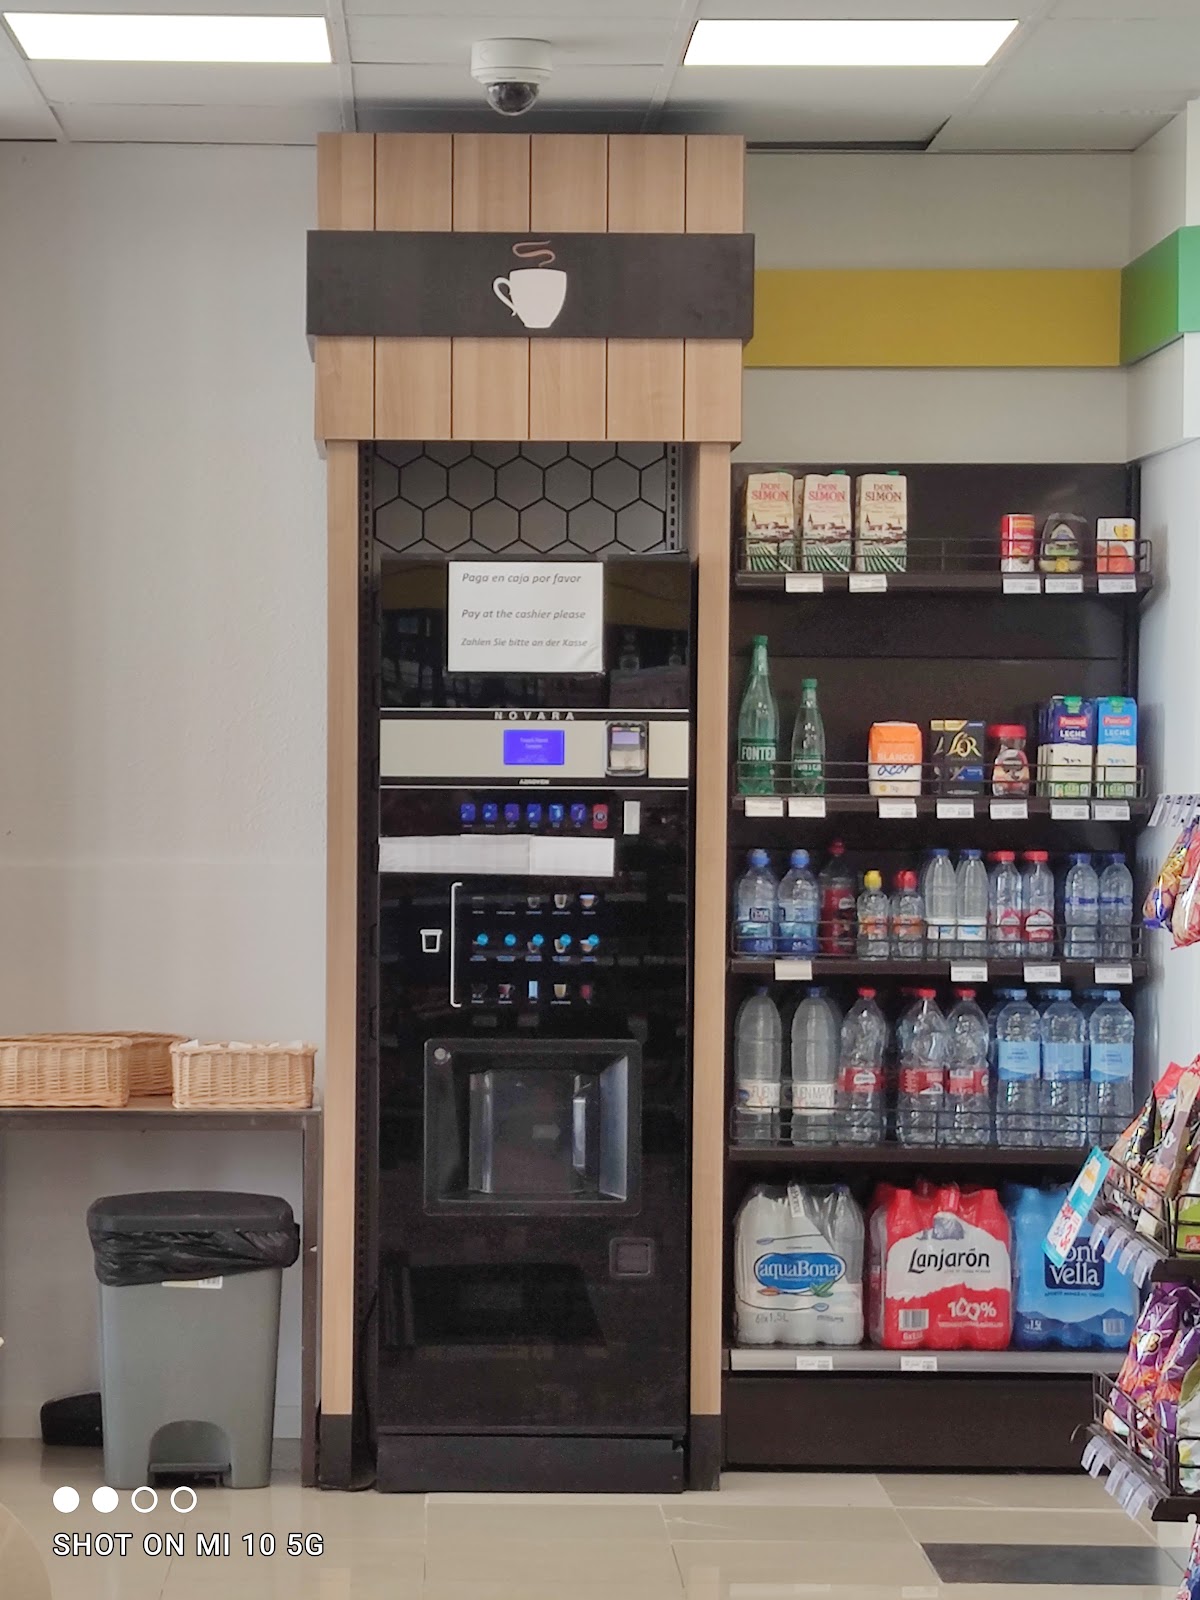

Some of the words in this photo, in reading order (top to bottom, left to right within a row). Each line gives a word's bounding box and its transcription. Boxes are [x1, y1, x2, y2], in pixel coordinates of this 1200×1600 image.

[760, 482, 781, 491] DON
[817, 483, 837, 491] DON
[873, 483, 893, 491] DON
[751, 490, 789, 501] SIMON
[808, 490, 845, 501] SIMON
[865, 491, 902, 502] SIMON
[462, 573, 489, 584] Paga
[491, 574, 505, 583] en
[507, 573, 530, 585] caja
[531, 575, 551, 584] por
[552, 573, 582, 585] favor
[461, 609, 480, 620] Pay
[482, 610, 493, 619] at
[496, 609, 513, 619] the
[515, 609, 551, 619] cashier
[553, 609, 586, 620] please
[461, 638, 491, 647] Zahlen
[493, 638, 507, 647] Sie
[508, 638, 529, 647] bitte
[545, 638, 560, 647] der
[562, 638, 588, 647] Kasse
[494, 711, 575, 720] NOVARA
[1060, 729, 1087, 738] LECHE
[1104, 729, 1131, 737] LECHE
[907, 1248, 990, 1274] Lanjarón
[759, 1260, 839, 1280] aquaBona
[1049, 1262, 1100, 1286] Vella
[947, 1297, 997, 1321] 100%
